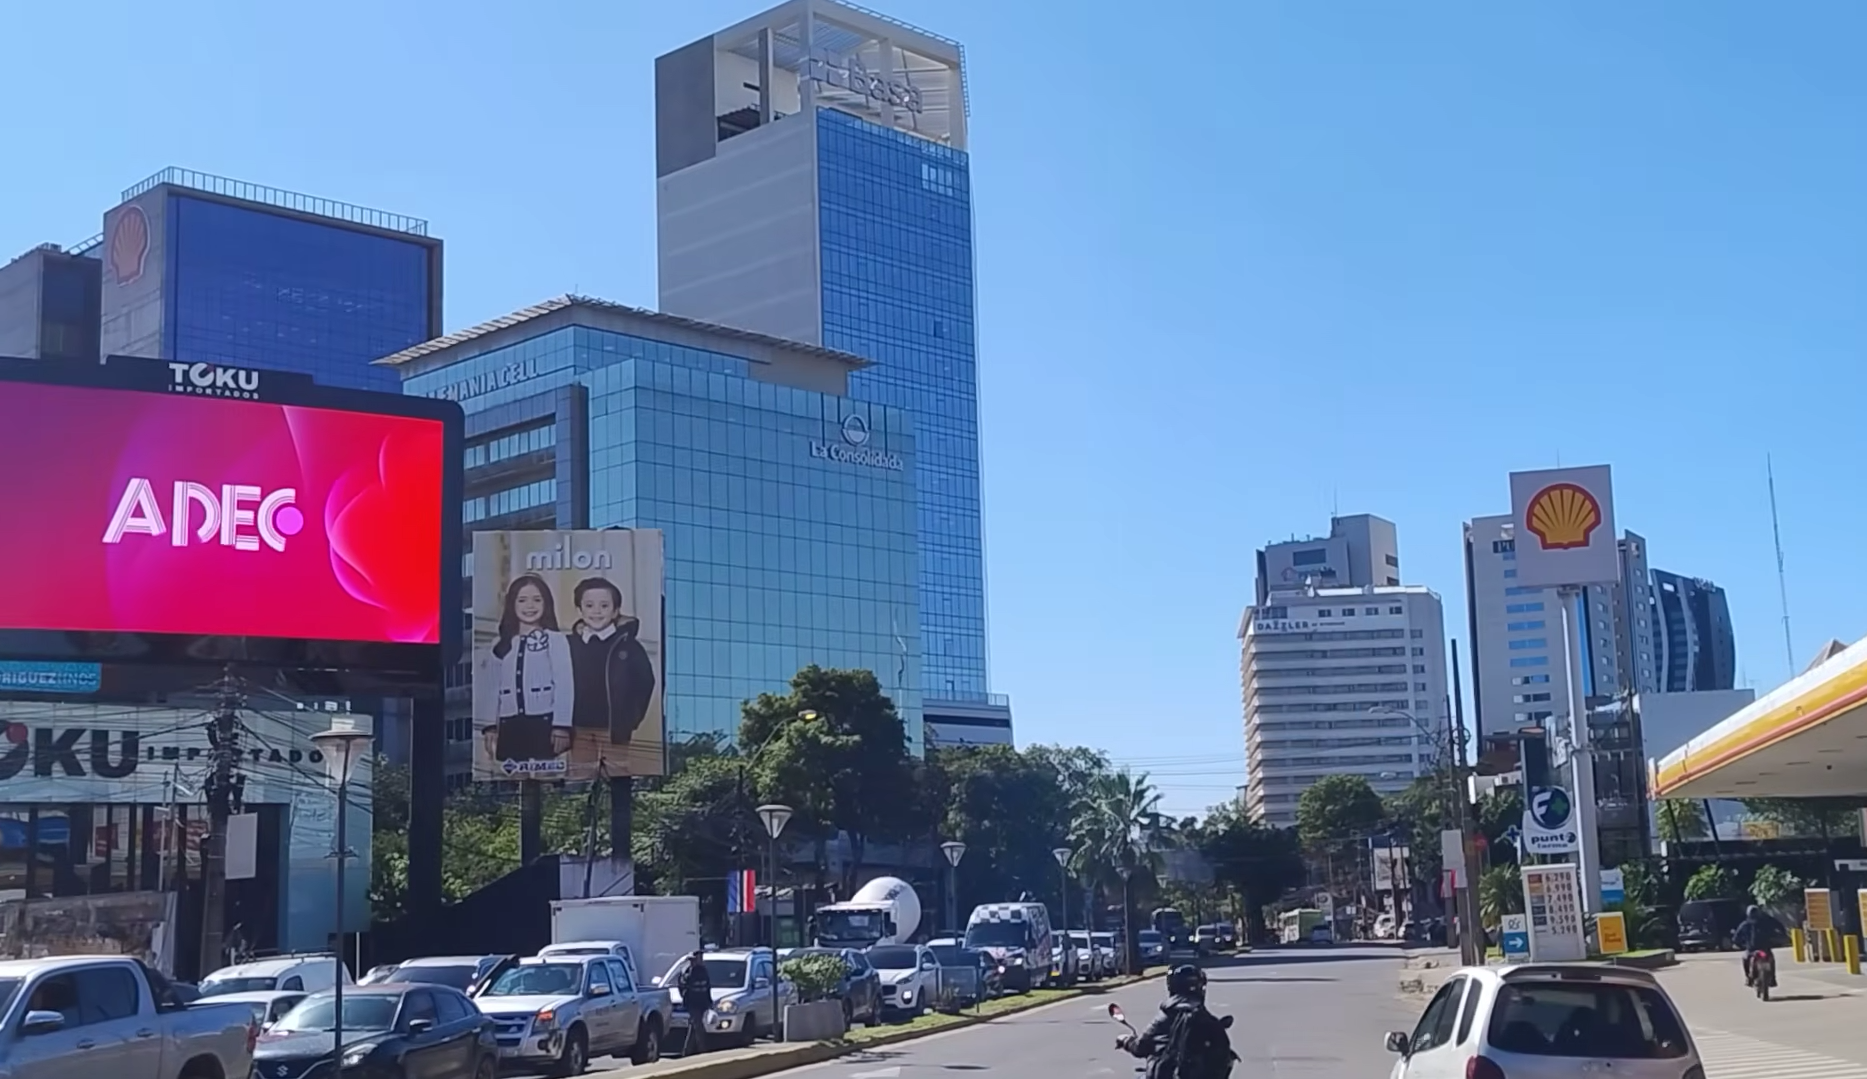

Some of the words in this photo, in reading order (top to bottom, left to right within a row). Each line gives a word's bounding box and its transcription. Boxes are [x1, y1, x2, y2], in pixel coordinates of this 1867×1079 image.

[168, 362, 259, 391] TOKU
[424, 358, 539, 401] EMANIACELL
[168, 384, 259, 400] IMPORTADOS
[810, 441, 829, 458] La
[830, 444, 904, 472] Consolidada
[102, 477, 304, 552] ADEC
[526, 534, 613, 571] milon
[0, 672, 56, 684] RIGUEZ
[1531, 832, 1576, 845] punto
